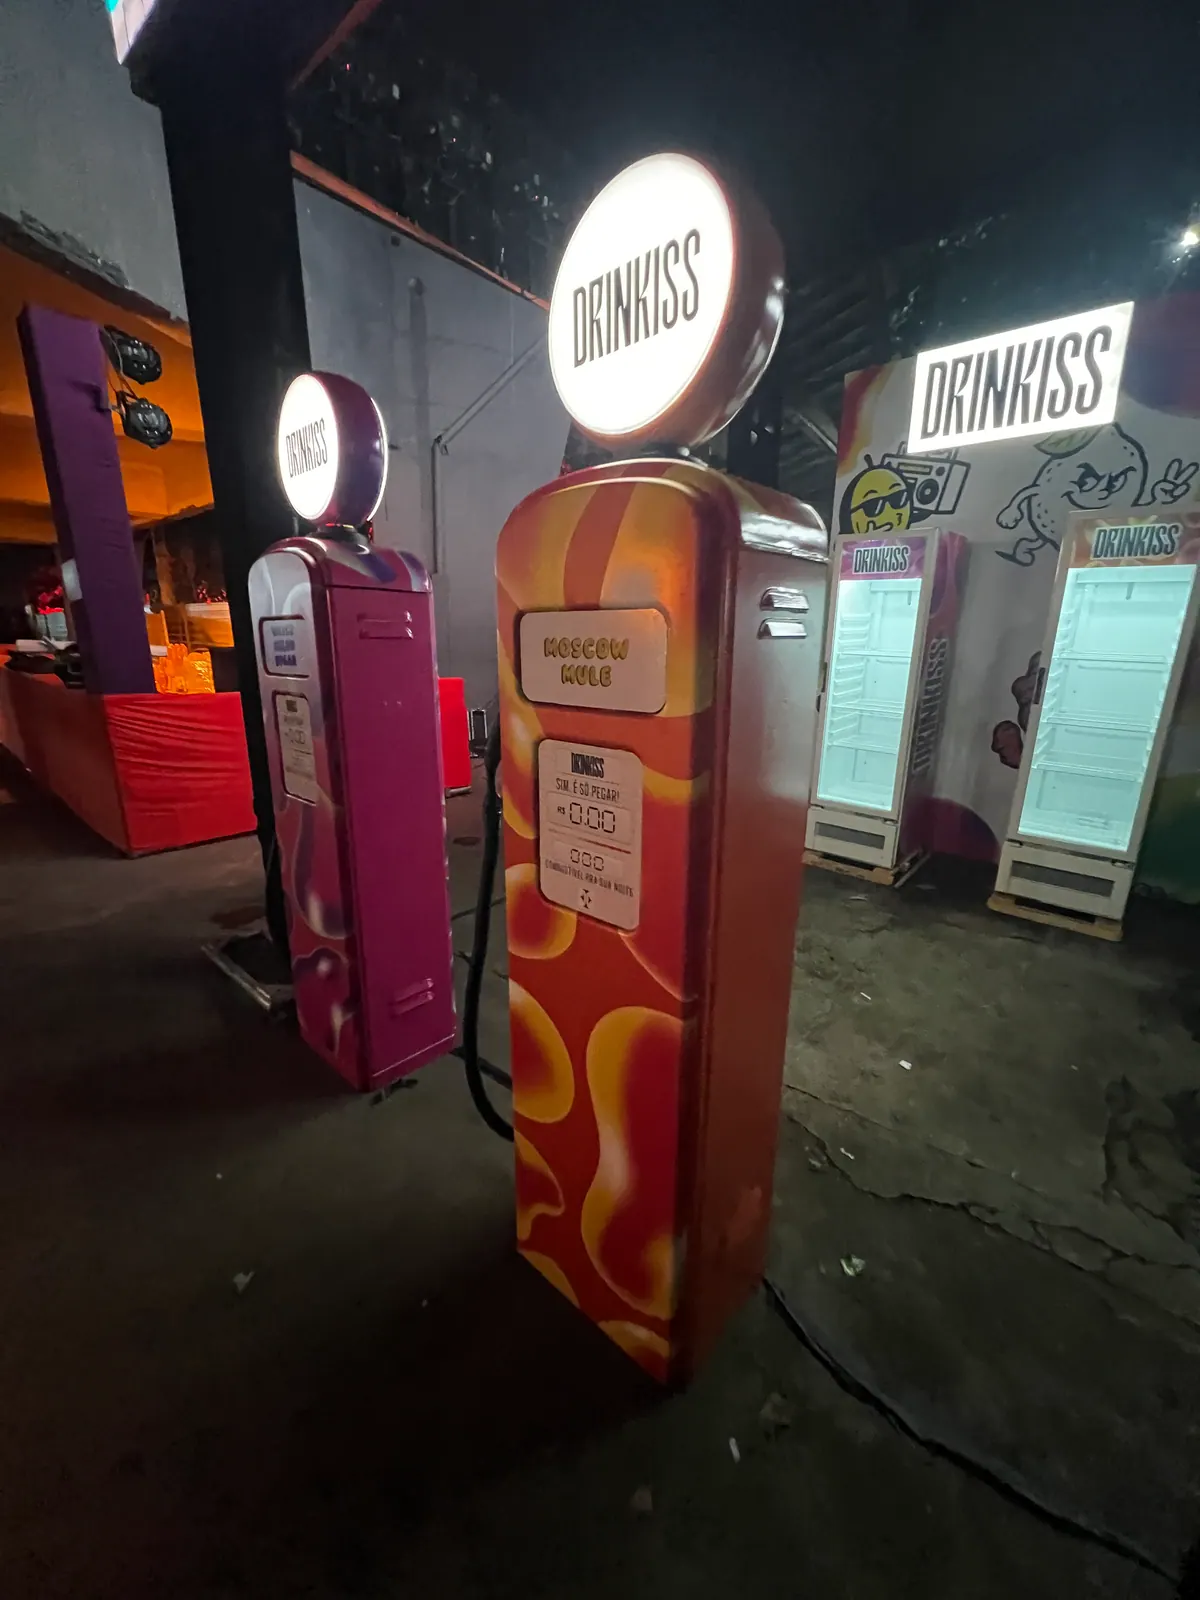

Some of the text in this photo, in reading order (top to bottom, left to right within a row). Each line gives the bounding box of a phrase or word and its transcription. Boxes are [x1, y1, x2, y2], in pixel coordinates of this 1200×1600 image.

[573, 228, 701, 369] DRINKISS
[920, 325, 1113, 440] DRINKISS
[285, 417, 329, 478] DRINKISS
[1093, 524, 1181, 560] DRINKISS
[854, 546, 910, 573] DRINKISS
[543, 637, 630, 660] MOSCOW
[561, 663, 612, 688] MULE
[591, 784, 621, 803] PEGAR!
[570, 848, 606, 872] 000
